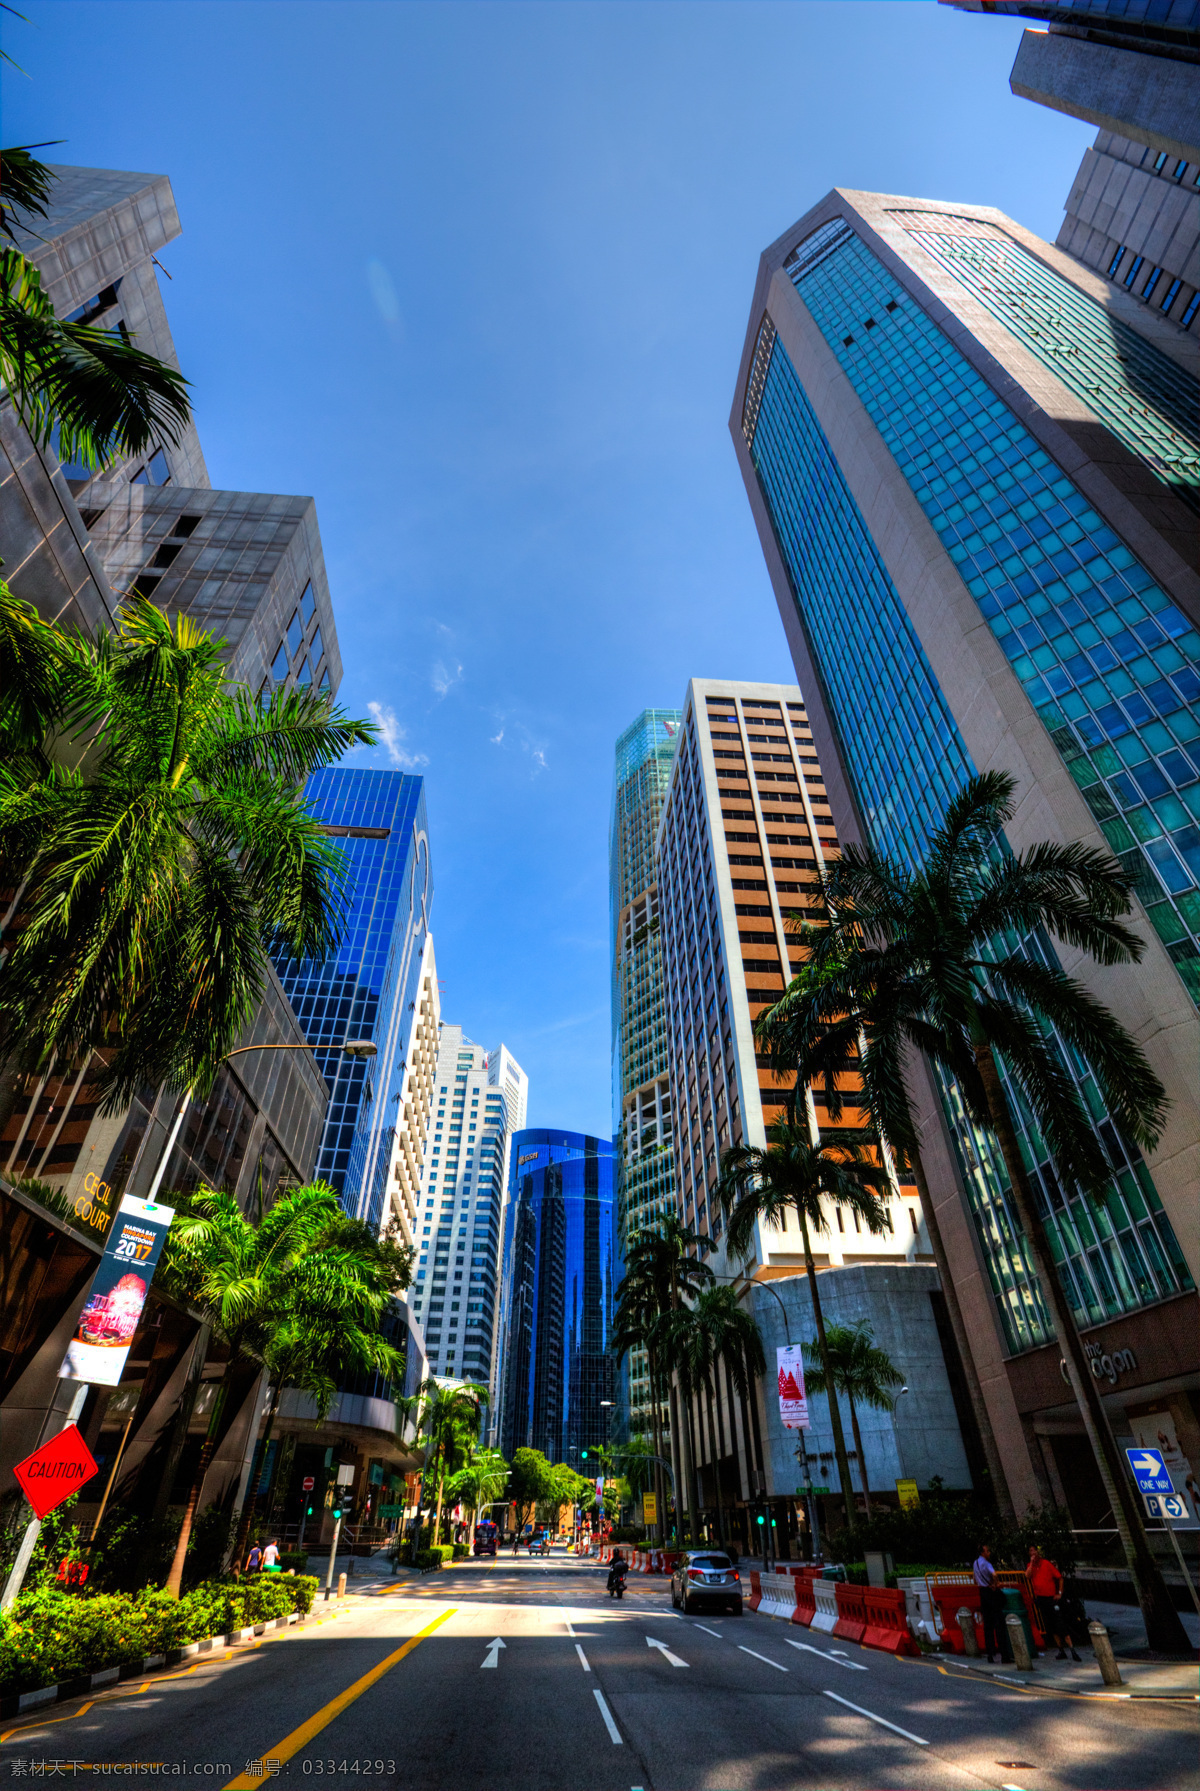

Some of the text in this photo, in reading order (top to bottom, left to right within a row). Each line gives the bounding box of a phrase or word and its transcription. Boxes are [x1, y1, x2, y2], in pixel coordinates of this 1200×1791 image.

[84, 1172, 111, 1205] CECIL
[75, 1196, 111, 1232] COURT
[122, 1228, 156, 1242] SINGAPORE
[124, 1224, 146, 1235] MARINA
[121, 1233, 154, 1246] COUNTDOWN
[115, 1239, 152, 1260] 2017
[1084, 1340, 1102, 1358] the
[27, 1462, 87, 1478] CAUTION
[1140, 1480, 1169, 1490] ONE WAY
[1150, 1500, 1158, 1514] P
